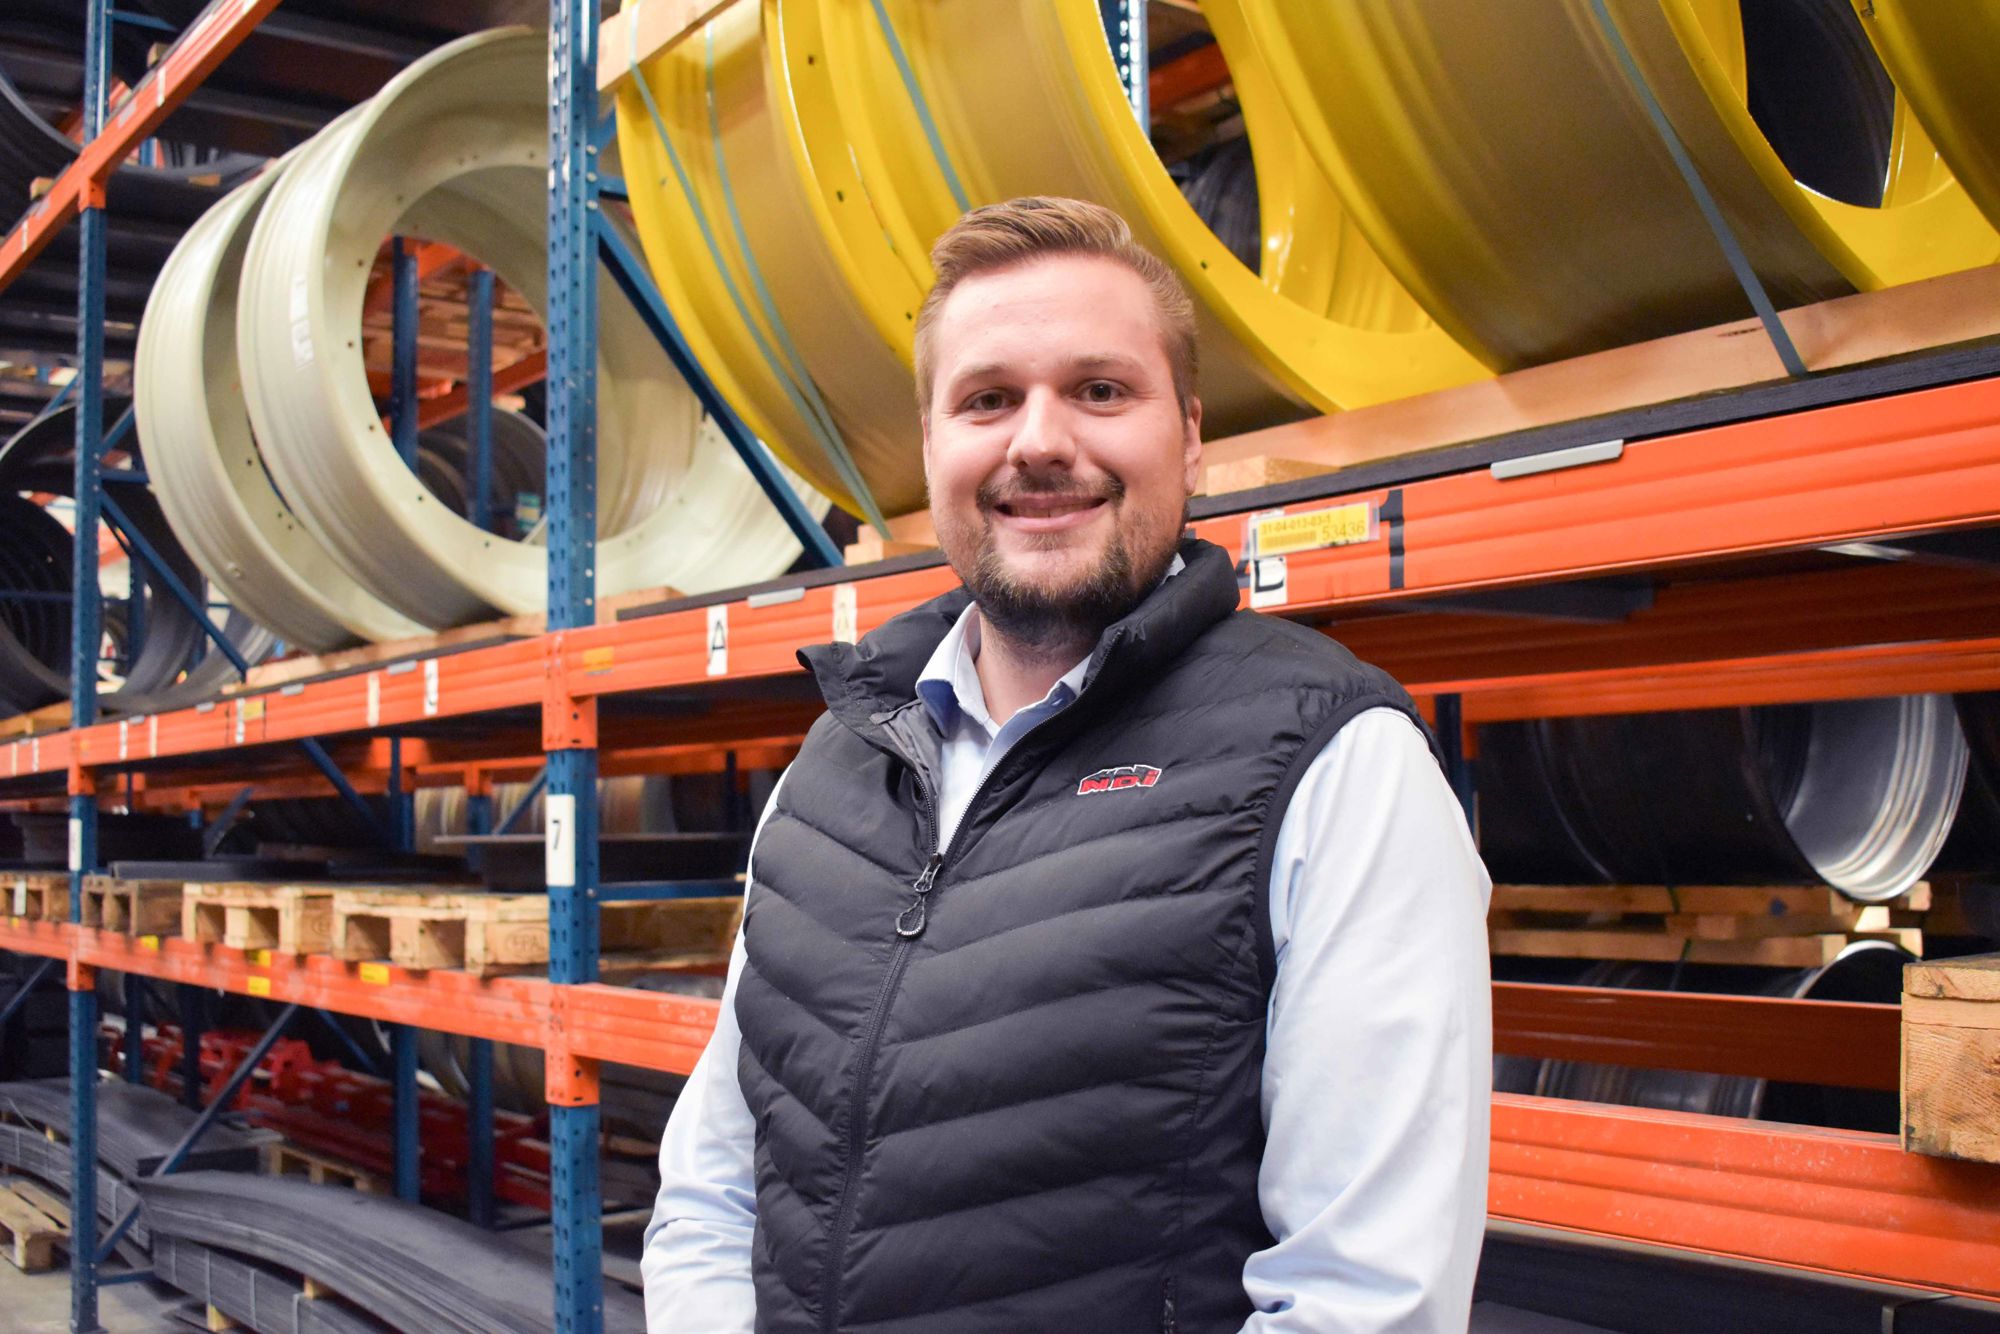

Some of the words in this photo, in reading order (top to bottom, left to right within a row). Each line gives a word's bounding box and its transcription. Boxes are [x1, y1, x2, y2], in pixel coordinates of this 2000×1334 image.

[1321, 522, 1366, 541] 53436
[1373, 488, 1404, 589] 1
[707, 620, 727, 665] A
[551, 818, 562, 851] 7
